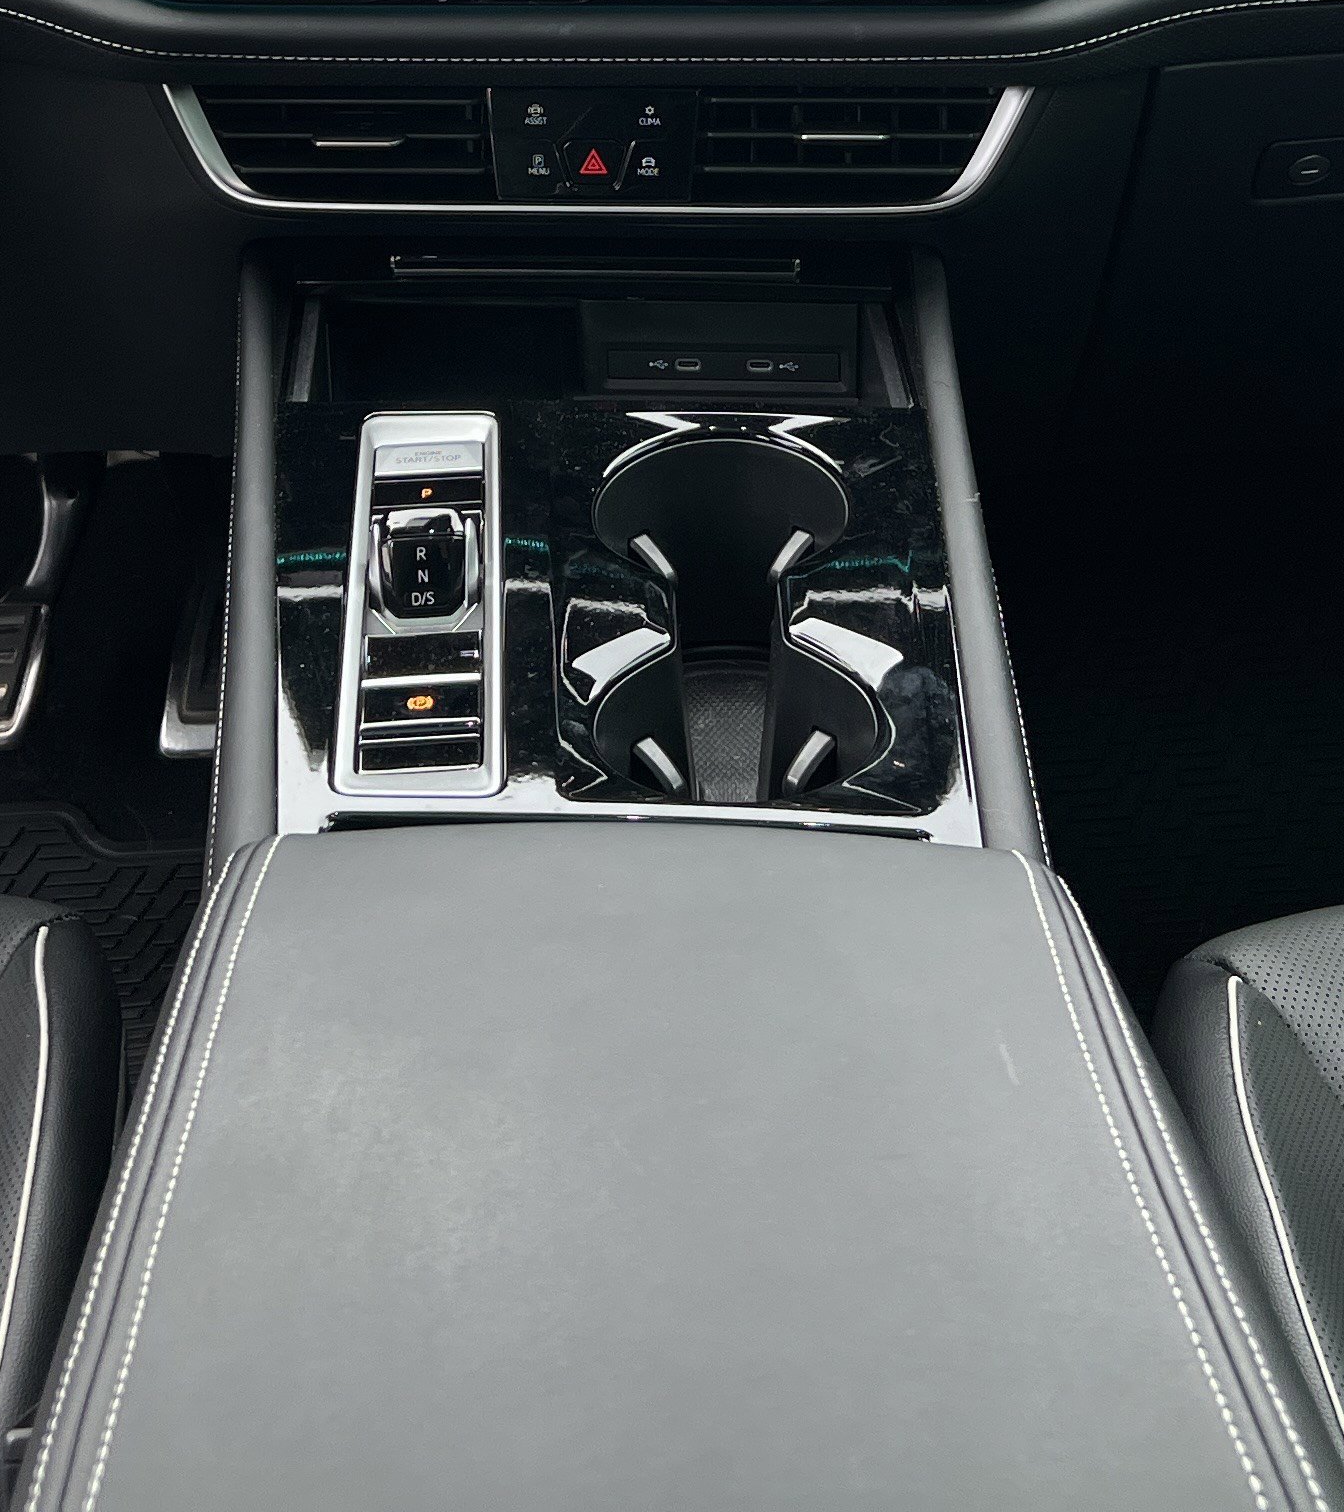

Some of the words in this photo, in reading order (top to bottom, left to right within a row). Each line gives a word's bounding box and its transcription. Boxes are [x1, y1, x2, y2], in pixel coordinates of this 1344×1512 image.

[528, 167, 550, 176] MENU
[637, 167, 659, 176] MODE
[396, 454, 462, 464] START/STOP
[421, 488, 433, 499] P
[416, 547, 427, 561] R
[418, 569, 429, 583] N
[411, 591, 435, 606] D/S
